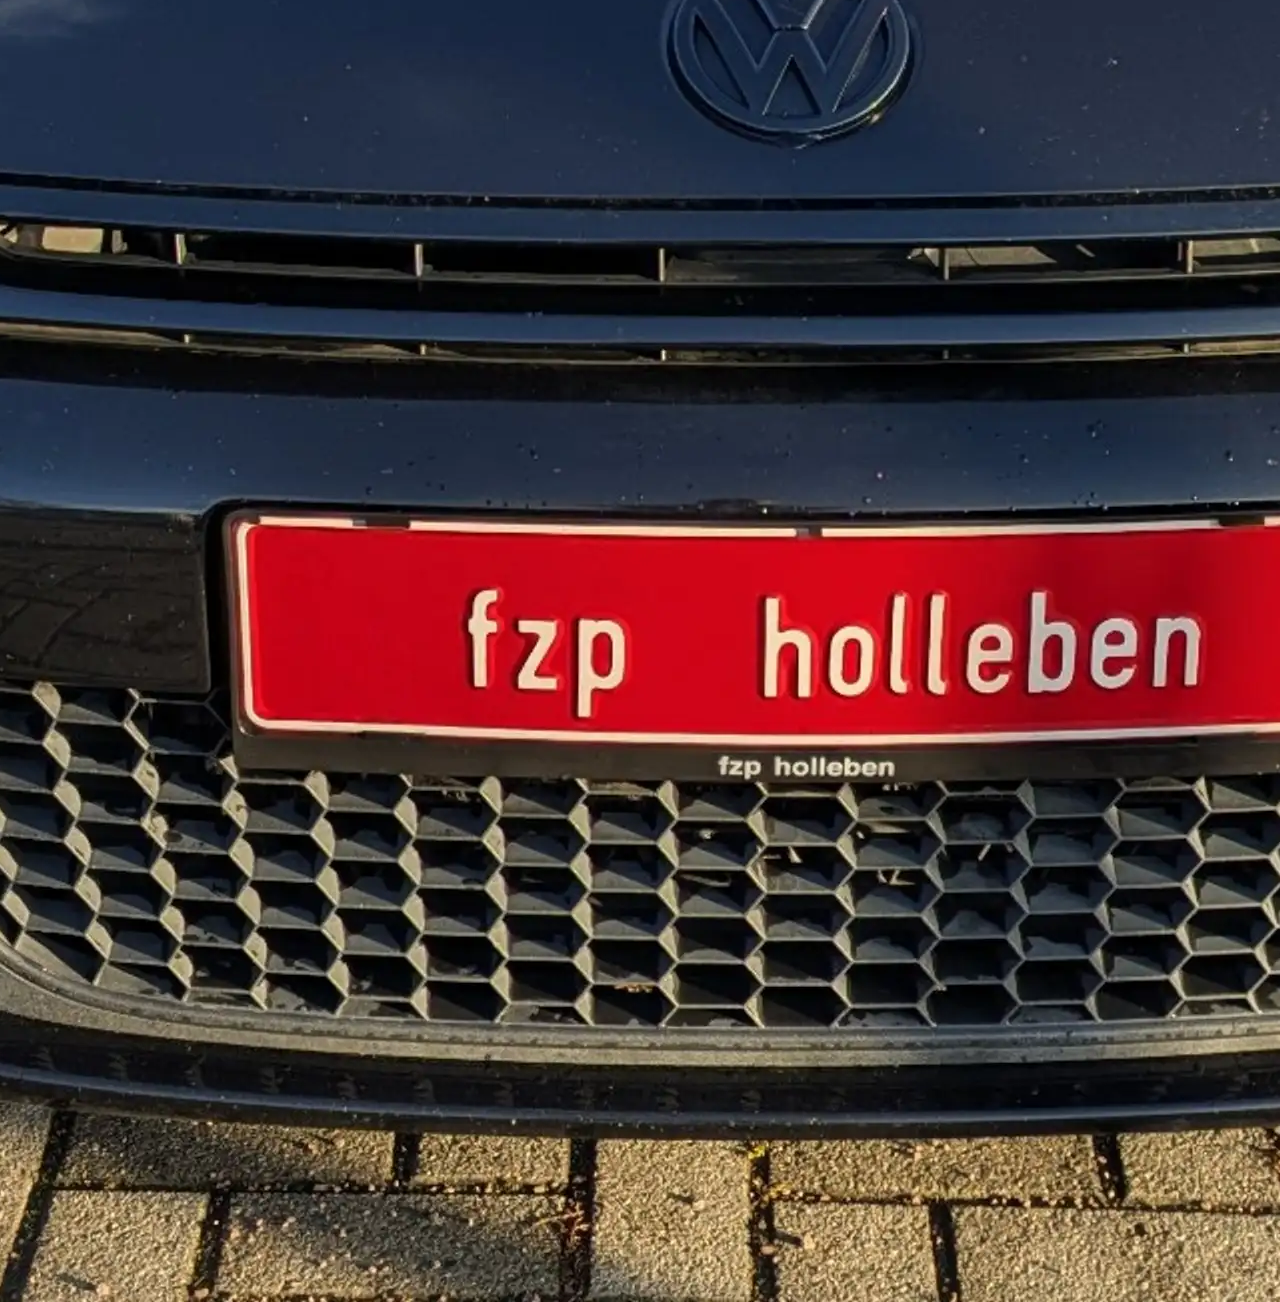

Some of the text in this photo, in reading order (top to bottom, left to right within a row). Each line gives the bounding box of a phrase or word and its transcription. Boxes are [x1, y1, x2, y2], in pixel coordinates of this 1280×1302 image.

[468, 589, 1200, 718] fzp holleben
[718, 756, 895, 780] fzp holleben
